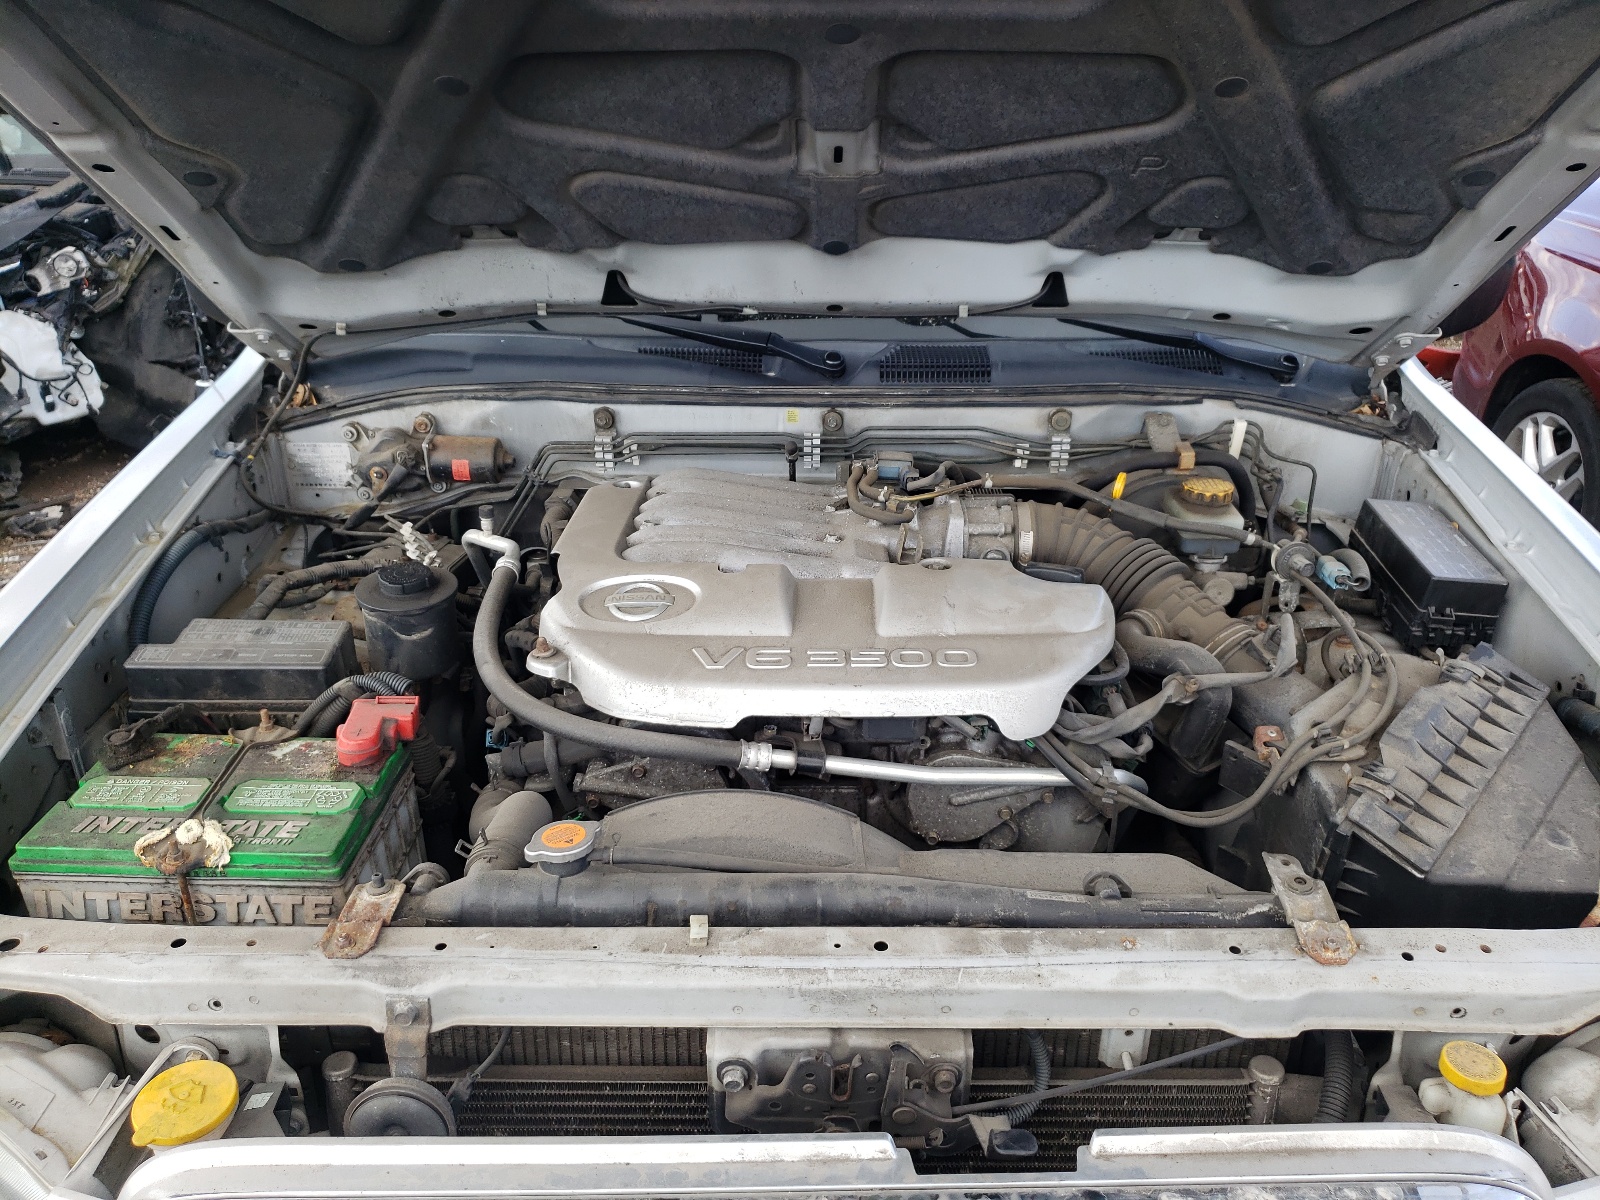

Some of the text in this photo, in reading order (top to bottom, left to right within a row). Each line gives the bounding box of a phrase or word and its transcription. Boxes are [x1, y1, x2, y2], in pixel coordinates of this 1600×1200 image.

[692, 648, 978, 669] V6 3500
[70, 815, 310, 839] INTETATE
